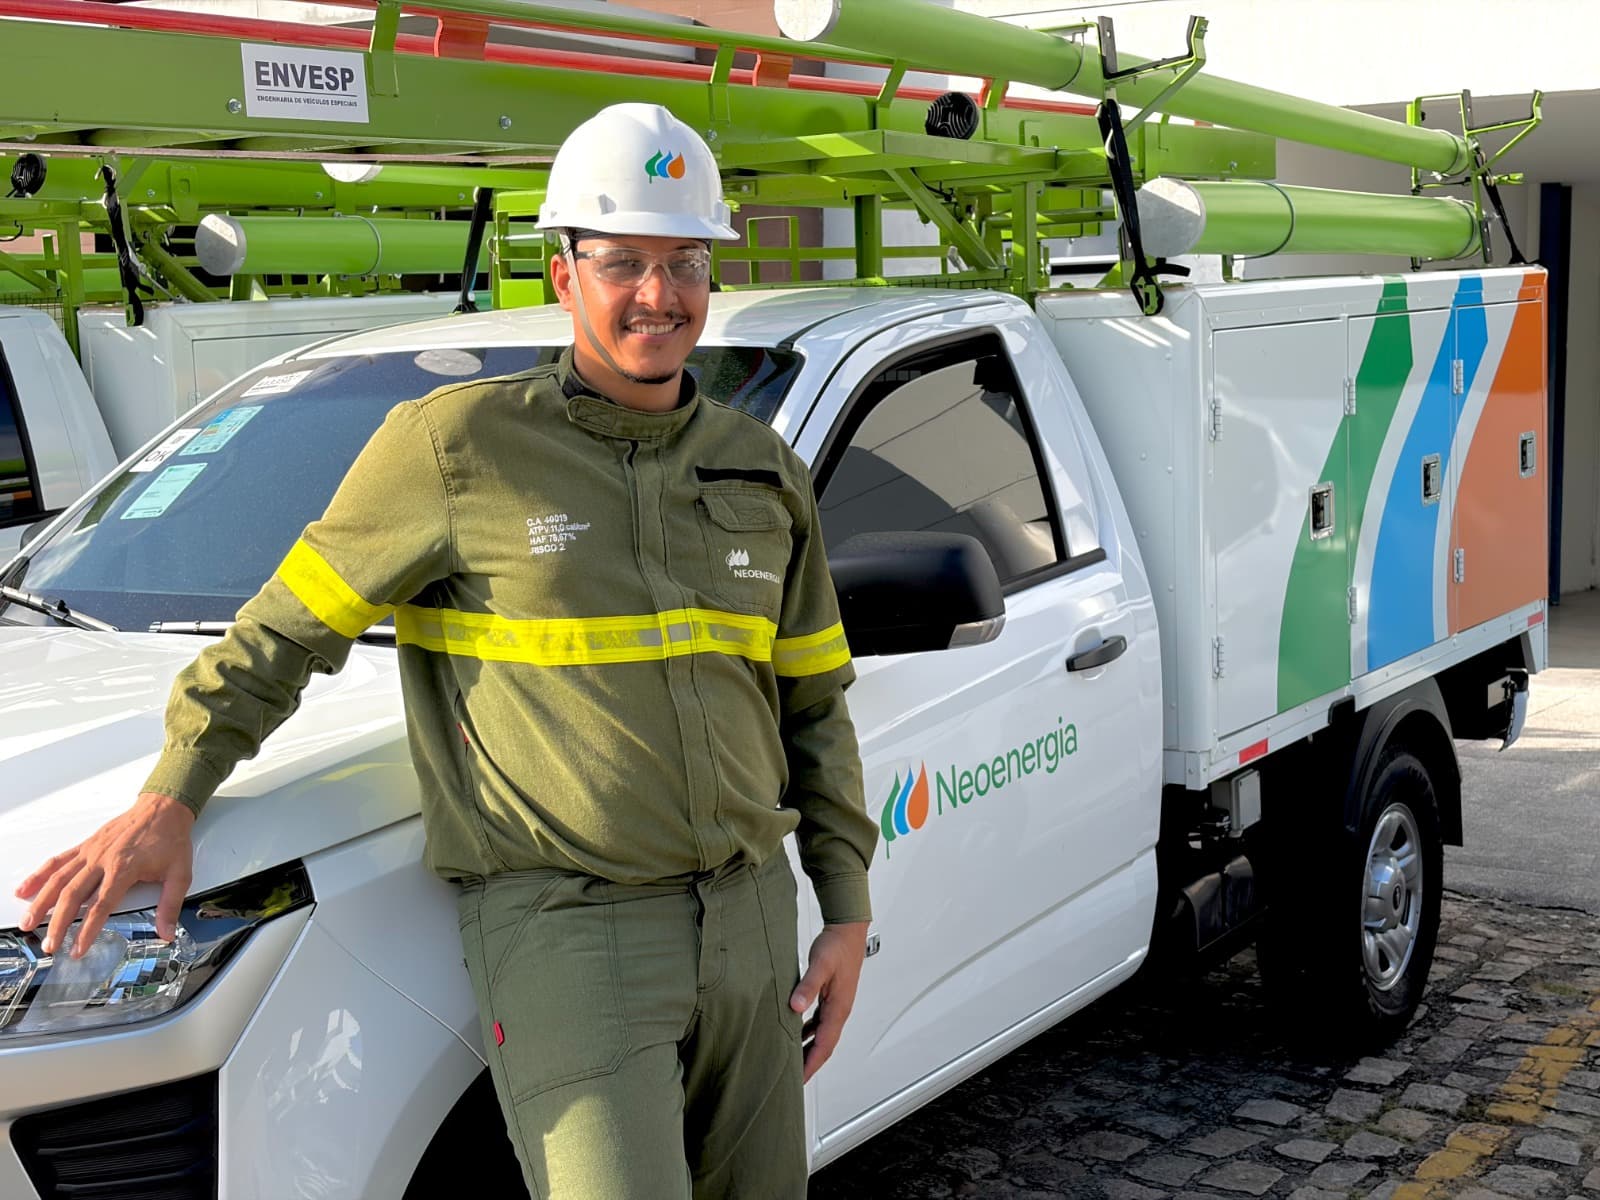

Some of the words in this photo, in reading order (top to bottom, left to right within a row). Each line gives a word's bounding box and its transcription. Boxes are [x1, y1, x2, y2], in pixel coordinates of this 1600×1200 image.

[255, 60, 355, 91] ENVESP
[528, 525, 549, 535] ATPV
[529, 535, 547, 545] HAF
[560, 543, 566, 551] 2
[936, 716, 1078, 816] Neoenergia
